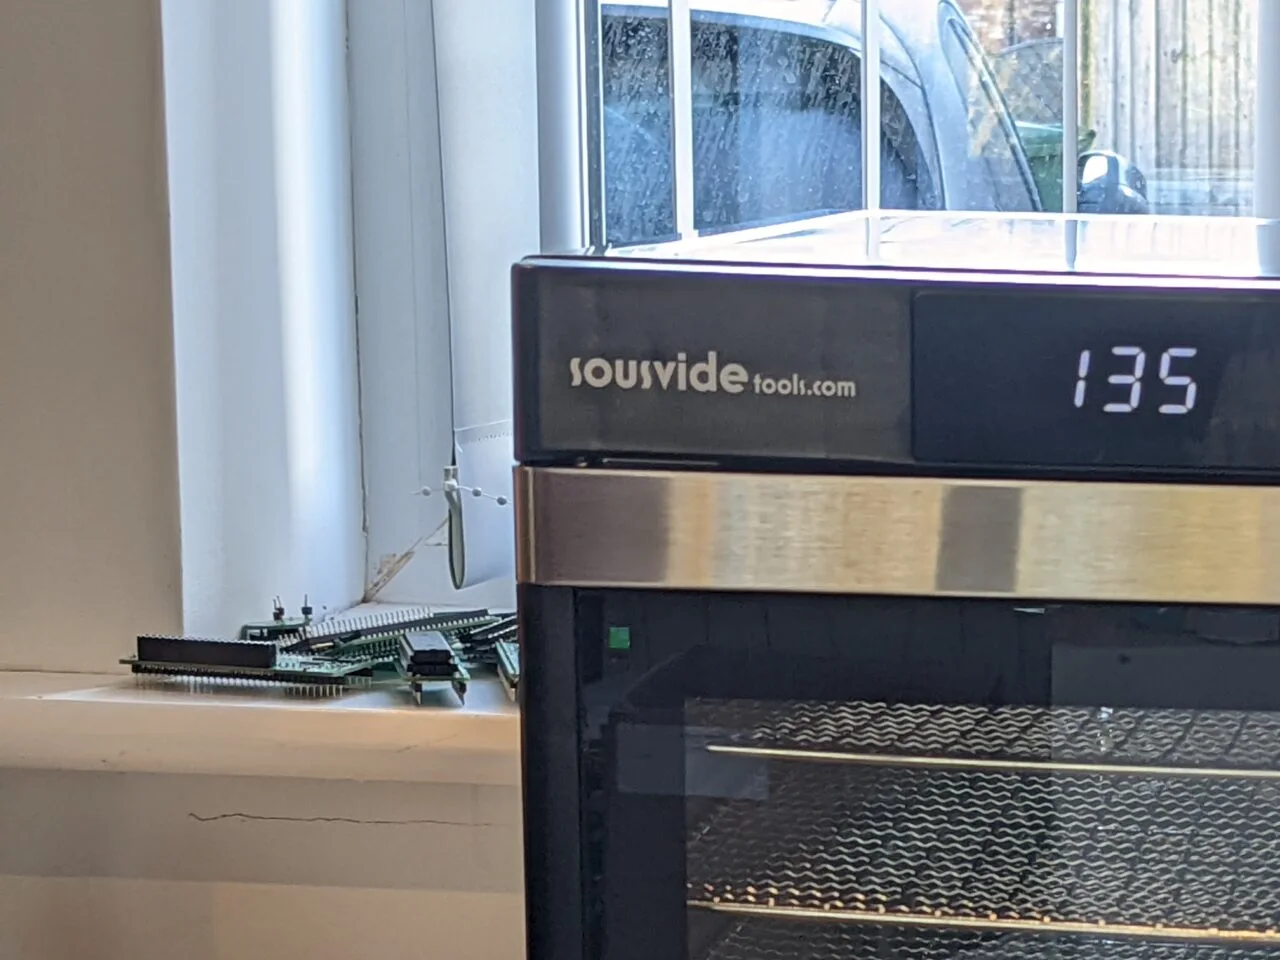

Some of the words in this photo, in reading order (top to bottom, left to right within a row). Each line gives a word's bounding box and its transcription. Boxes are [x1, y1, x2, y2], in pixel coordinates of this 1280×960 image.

[569, 351, 749, 394] sousvide
[753, 373, 857, 397] tools.com
[1073, 346, 1197, 414] 135
